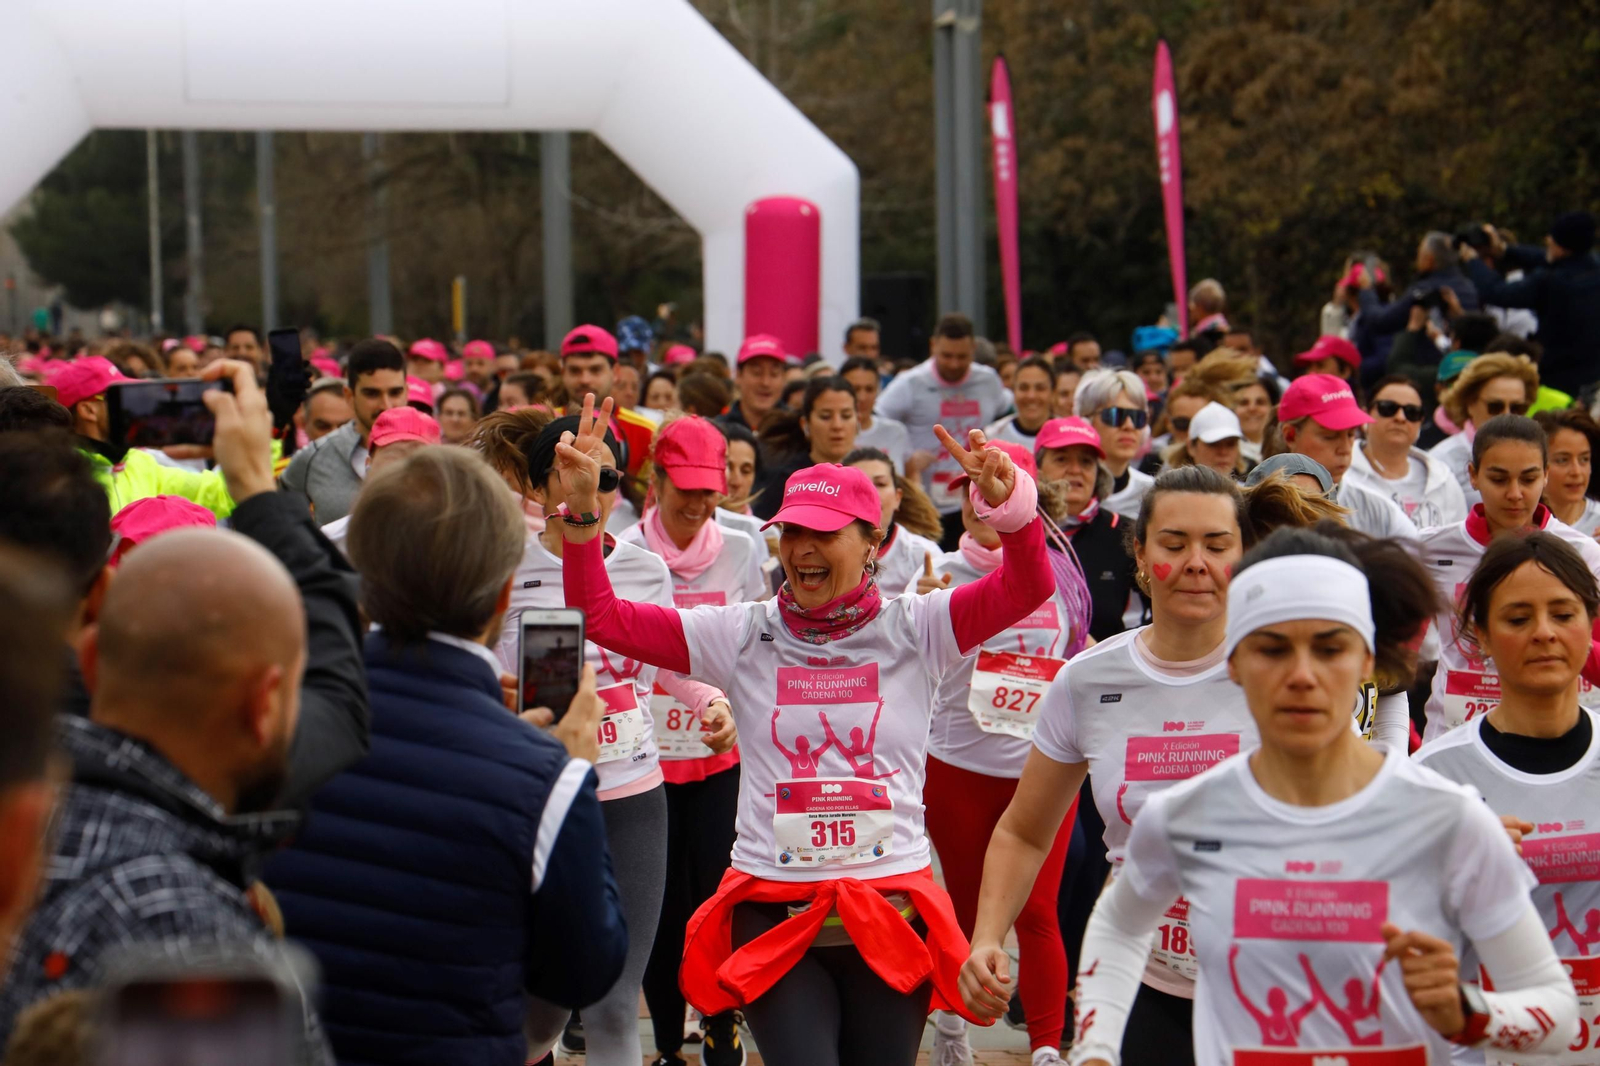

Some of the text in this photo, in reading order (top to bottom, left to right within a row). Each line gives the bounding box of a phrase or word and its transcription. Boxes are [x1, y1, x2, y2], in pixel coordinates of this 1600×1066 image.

[787, 481, 840, 497] sinvello!
[787, 677, 867, 690] PINK RUNNING
[802, 690, 853, 699] CADENA 100
[992, 686, 1041, 713] 827
[1465, 701, 1499, 722] 22
[1163, 721, 1185, 732] 100
[1171, 741, 1200, 750] Edición
[1137, 750, 1225, 763] PINK RUNNING
[1152, 764, 1208, 774] CADENA 100
[821, 784, 842, 794] 100
[811, 820, 856, 847] 315
[1250, 898, 1372, 919] PINK RUNNING
[1271, 918, 1349, 934] CADENA 100
